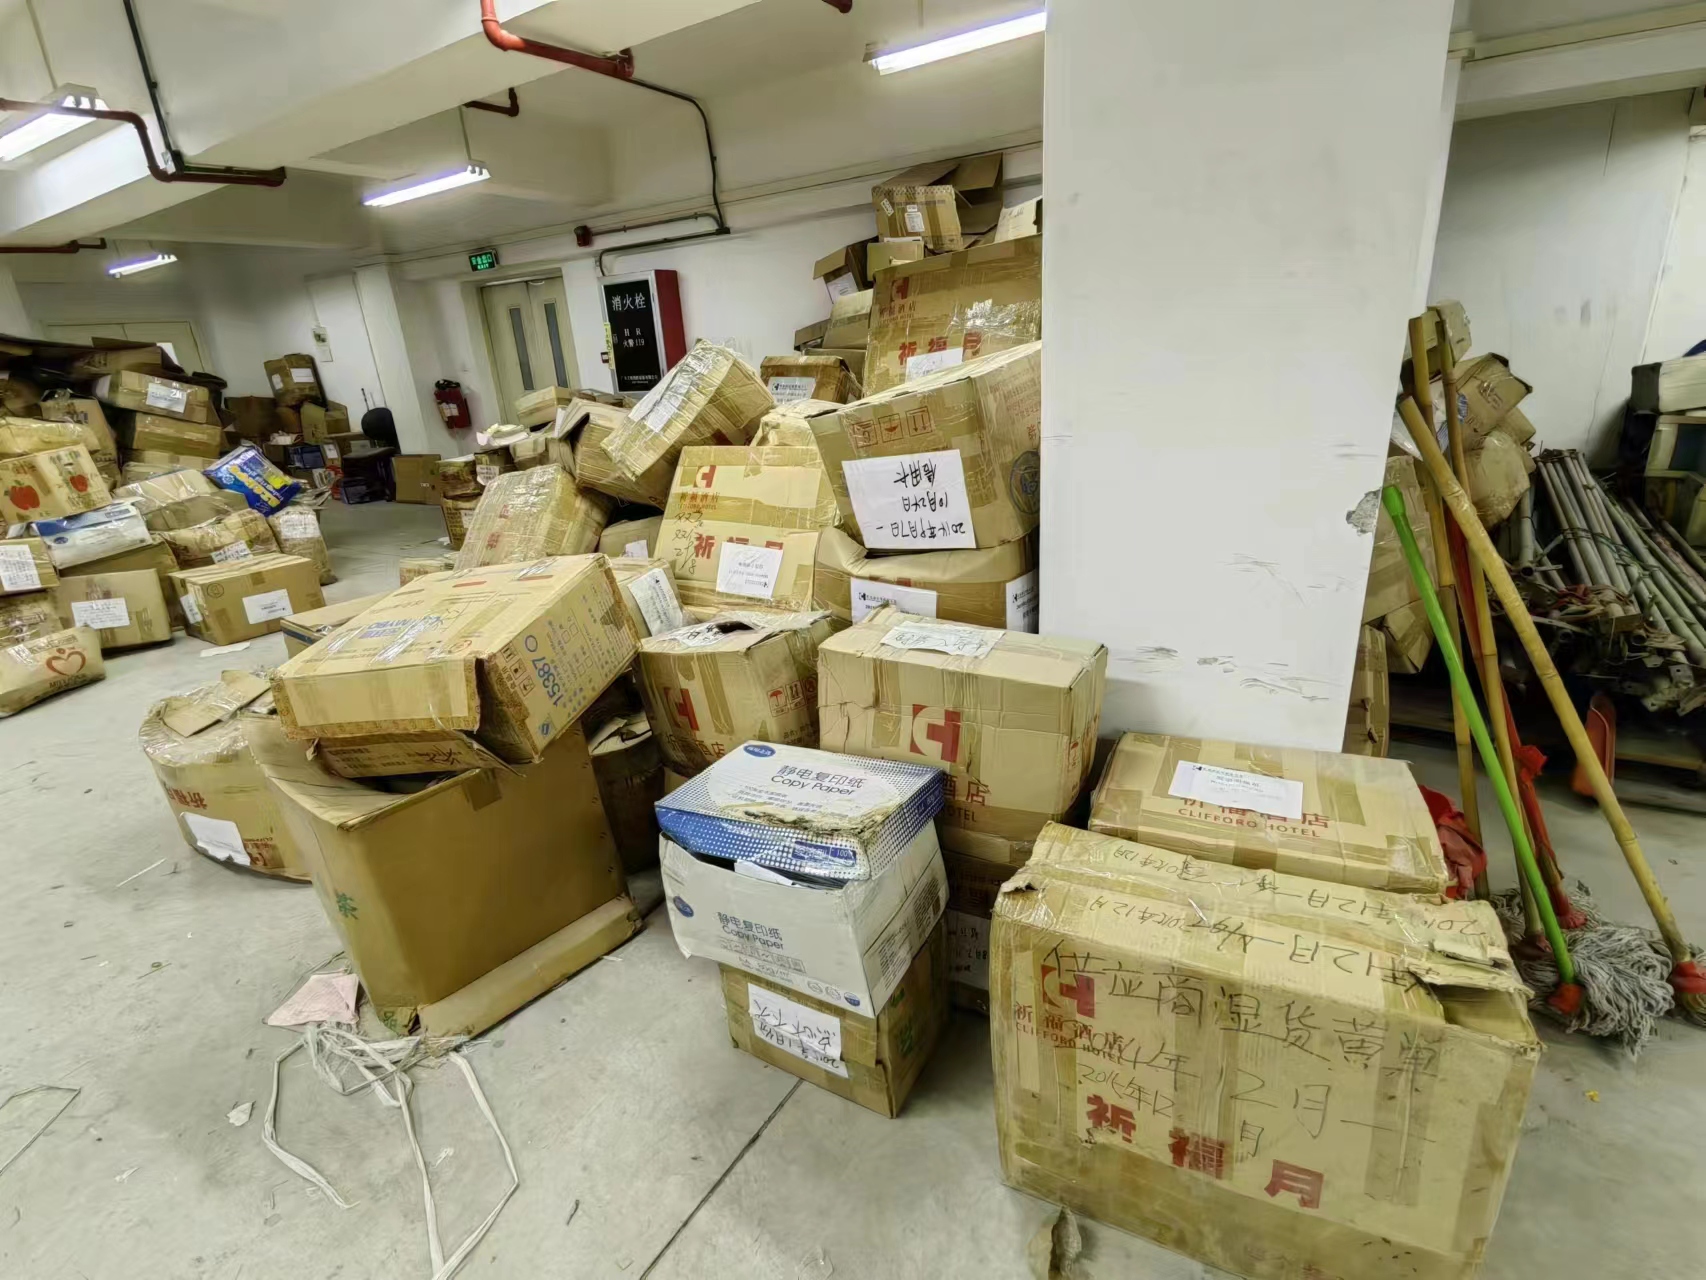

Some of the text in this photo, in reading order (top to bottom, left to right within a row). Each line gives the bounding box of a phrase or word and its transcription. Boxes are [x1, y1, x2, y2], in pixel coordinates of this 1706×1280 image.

[611, 292, 647, 311] 消火栓
[893, 459, 937, 488] 信用卡
[770, 774, 856, 797] Copy Paper
[777, 763, 867, 789] 静电复印纸
[1265, 822, 1321, 838] HOTEL
[716, 911, 783, 941] 静电复印纸
[722, 924, 784, 950] Copy Paper
